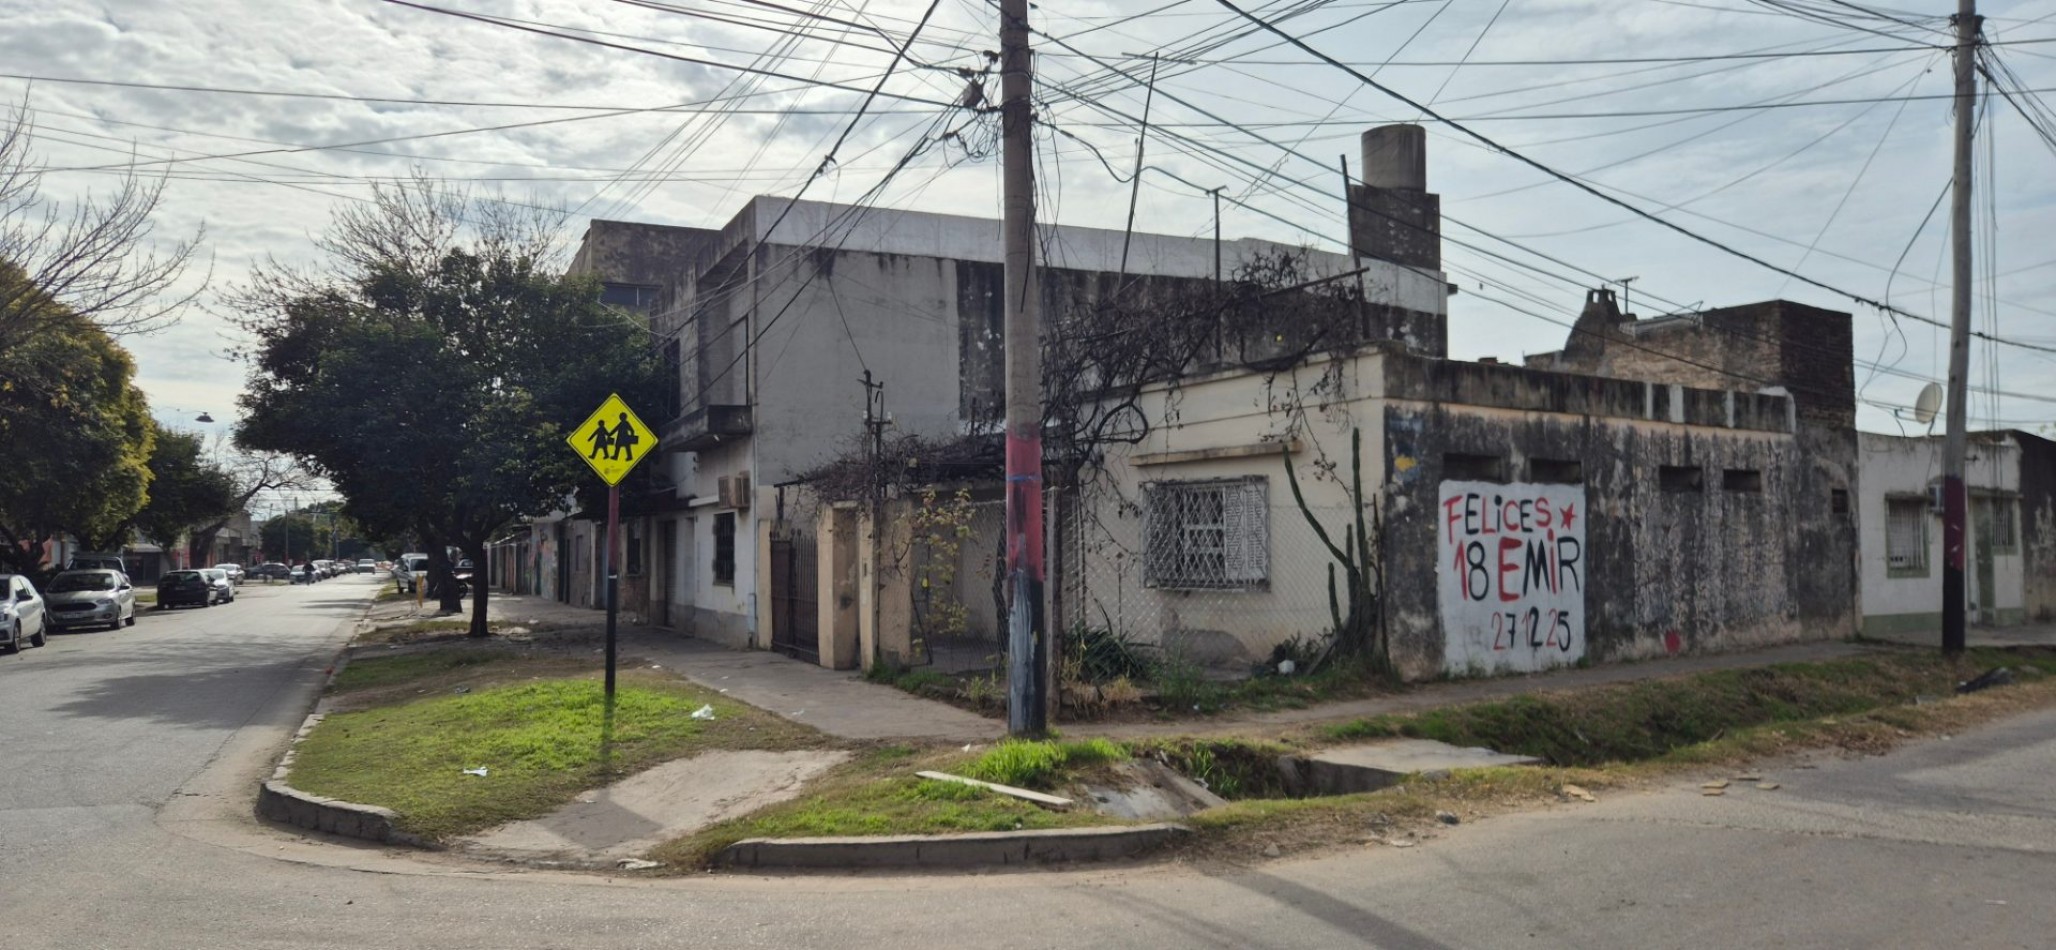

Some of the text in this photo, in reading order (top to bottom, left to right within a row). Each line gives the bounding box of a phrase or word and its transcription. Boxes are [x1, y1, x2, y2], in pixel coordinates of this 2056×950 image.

[1454, 539, 1490, 602] 18
[1491, 606, 1571, 652] 27 12 25
